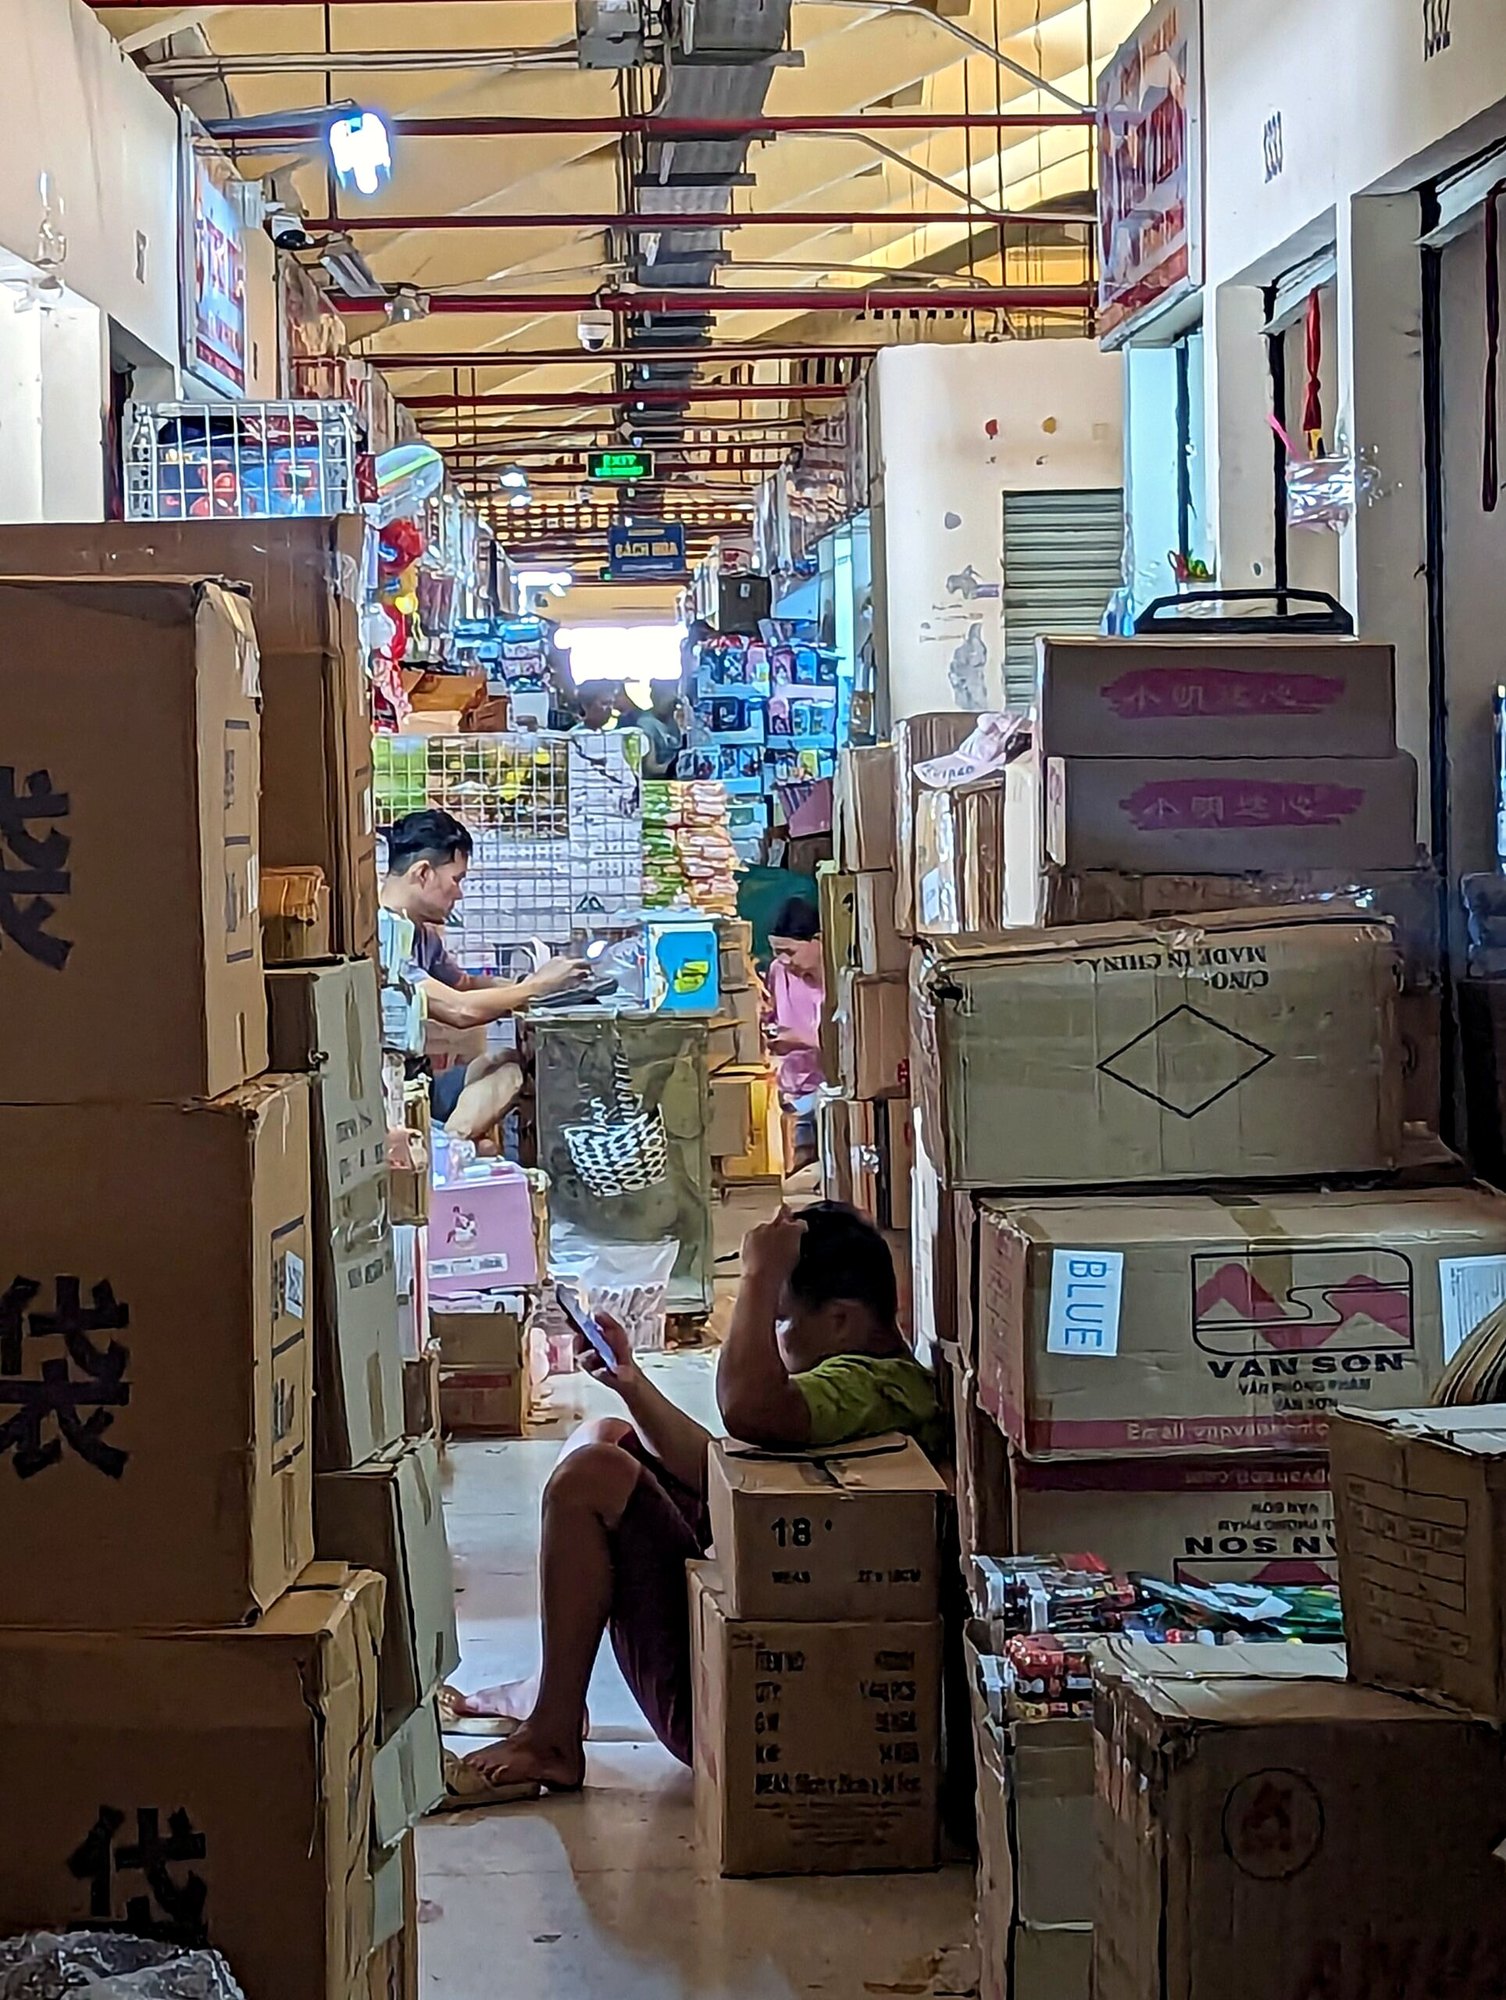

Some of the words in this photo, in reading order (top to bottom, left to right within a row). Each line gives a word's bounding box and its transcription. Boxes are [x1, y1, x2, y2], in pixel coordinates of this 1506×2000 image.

[1168, 950, 1191, 969] IN
[1199, 946, 1267, 965] MADE
[1064, 1260, 1107, 1347] BLUE
[1185, 1536, 1278, 1555] SON
